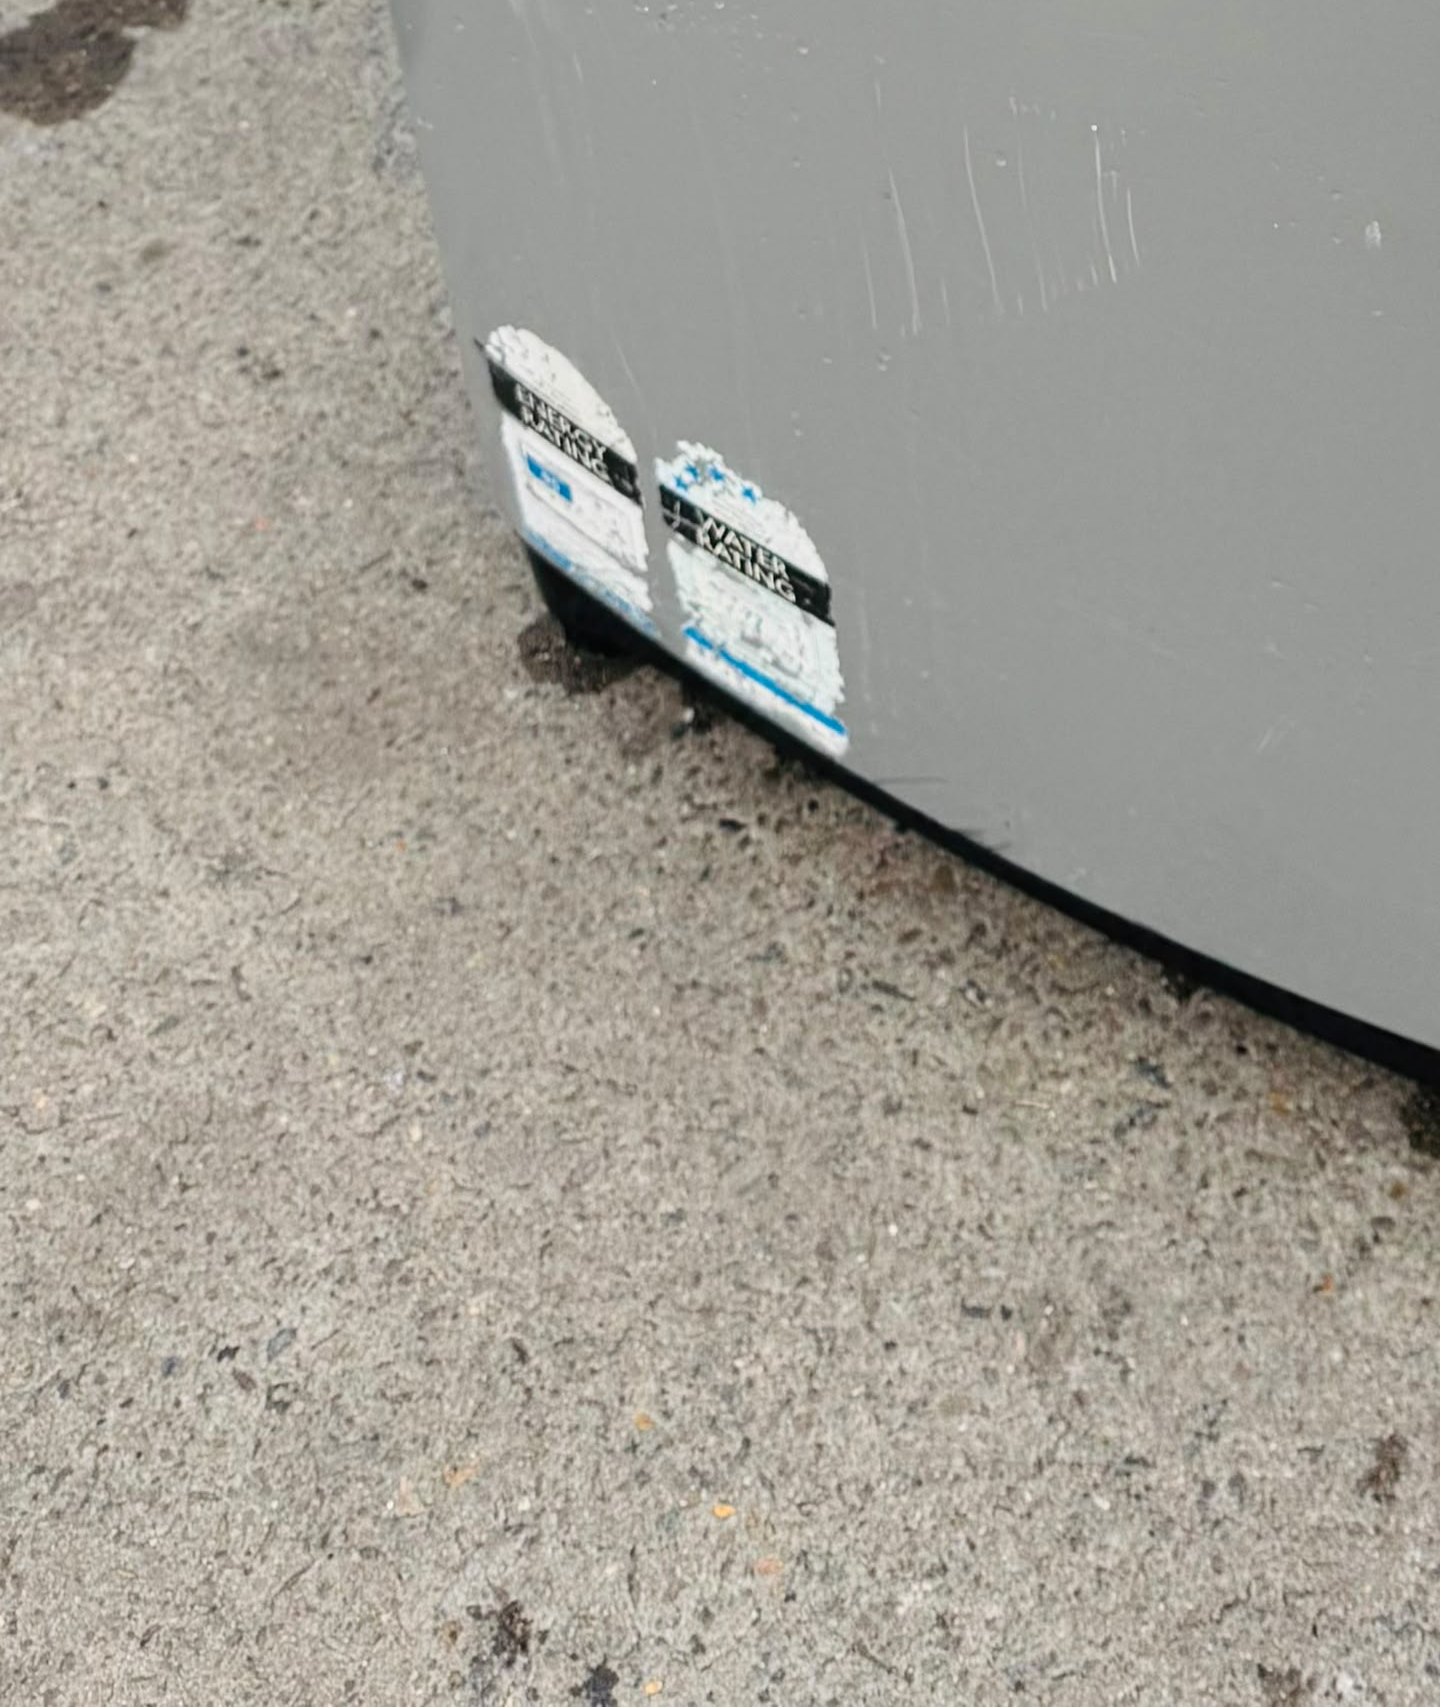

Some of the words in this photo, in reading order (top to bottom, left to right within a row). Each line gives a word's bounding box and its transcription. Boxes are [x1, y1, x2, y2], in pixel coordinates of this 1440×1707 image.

[515, 383, 607, 461] ENERGY
[521, 404, 613, 484] RATING
[695, 507, 791, 582] WATER
[696, 527, 796, 603] RATING
